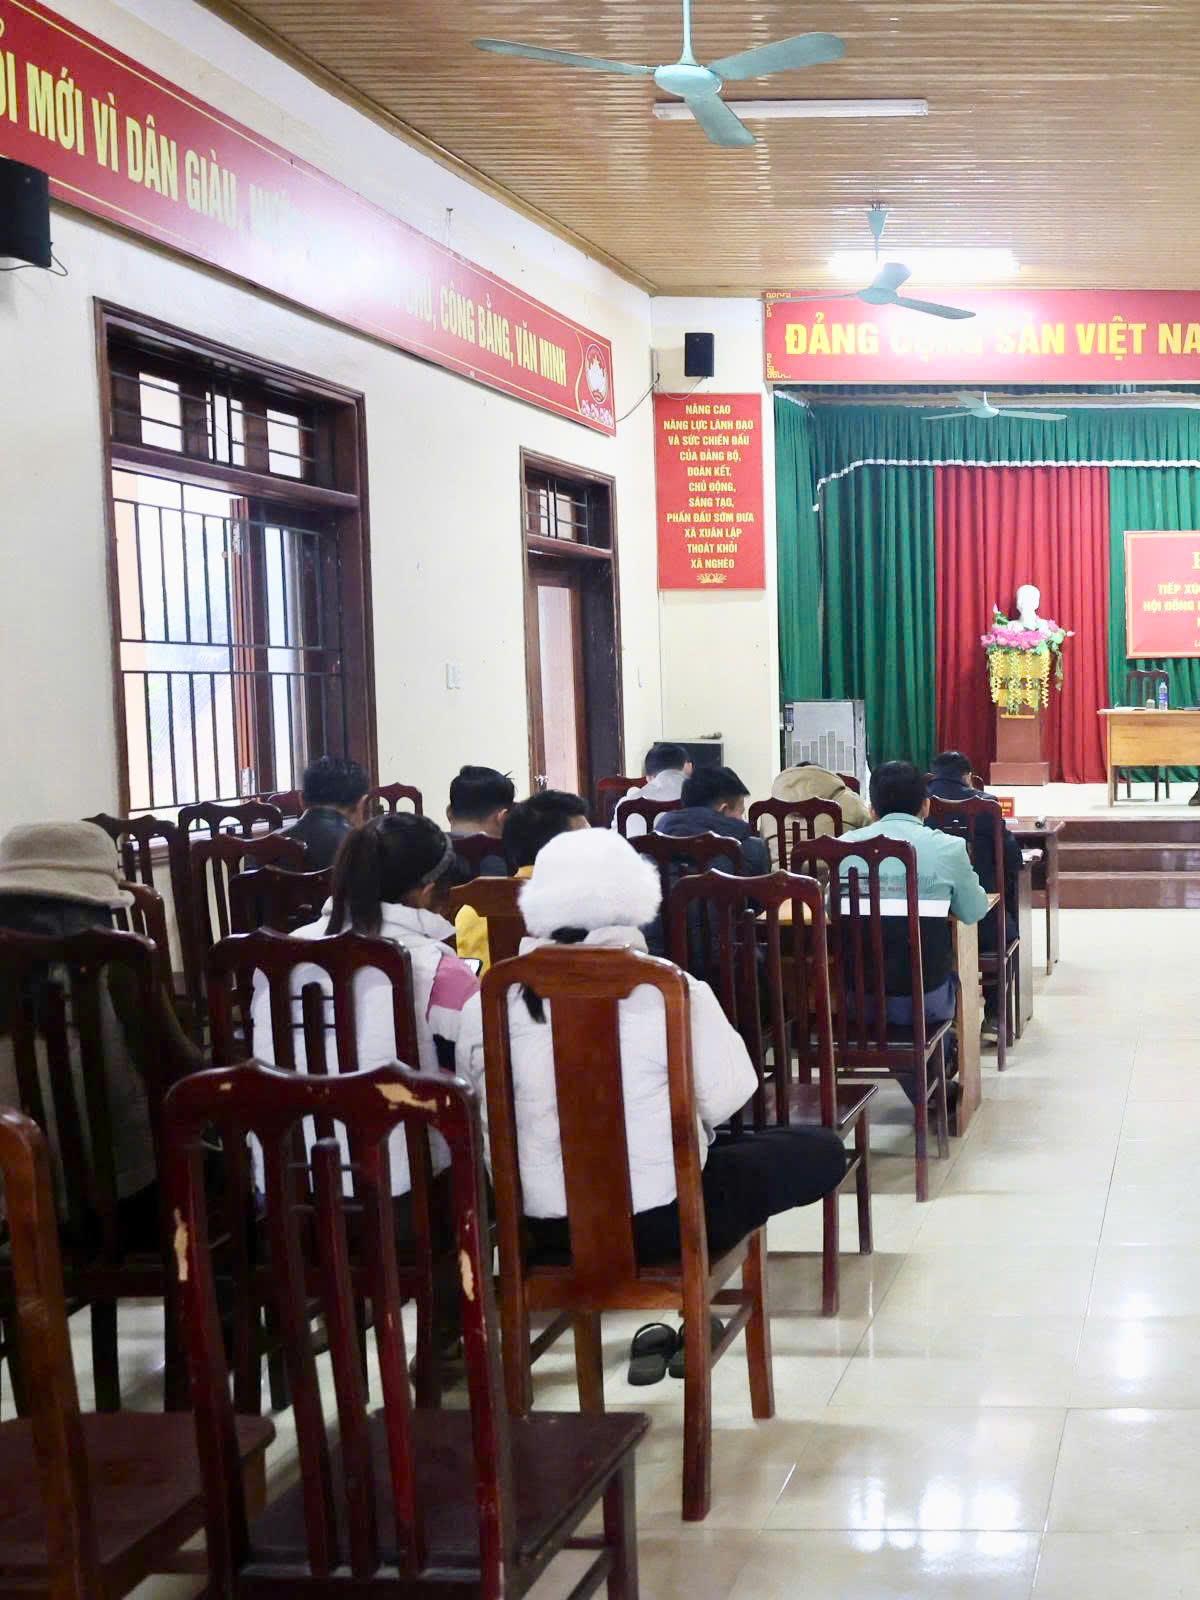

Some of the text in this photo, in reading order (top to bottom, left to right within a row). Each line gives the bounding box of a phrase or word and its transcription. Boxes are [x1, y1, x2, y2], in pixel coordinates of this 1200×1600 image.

[26, 66, 85, 156] MỚI
[91, 91, 119, 172] VÌ
[126, 113, 178, 202] DÂN
[440, 280, 476, 344] CÔNG
[478, 293, 514, 367] BẰNG,
[515, 320, 538, 373] VĂN
[539, 337, 567, 387] MINH
[785, 311, 879, 355] ĐẢNG
[1075, 315, 1147, 360] VIỆT
[713, 405, 731, 415] CAO
[691, 419, 708, 432] LỰC
[710, 418, 733, 430] LÃNH
[735, 420, 754, 432] ĐẠO
[668, 432, 749, 445] VÀ SỨC CHIẾN ĐẤU
[679, 448, 741, 463] CỦA ĐẢNG BỘ,
[687, 464, 712, 476] ĐOÀN
[688, 479, 736, 494] CHỦ ĐỘNG,
[688, 496, 713, 507] SÁNG
[666, 509, 754, 523] PHẤN ĐẤU SỚM ĐƯA
[684, 526, 742, 540] XÃ XUÂN LẬP
[687, 540, 738, 553] THOÁT KHỎI
[690, 557, 735, 569] XÃ NGHÈO
[1158, 581, 1181, 594] TIẾP
[1143, 599, 1161, 613] HỘI
